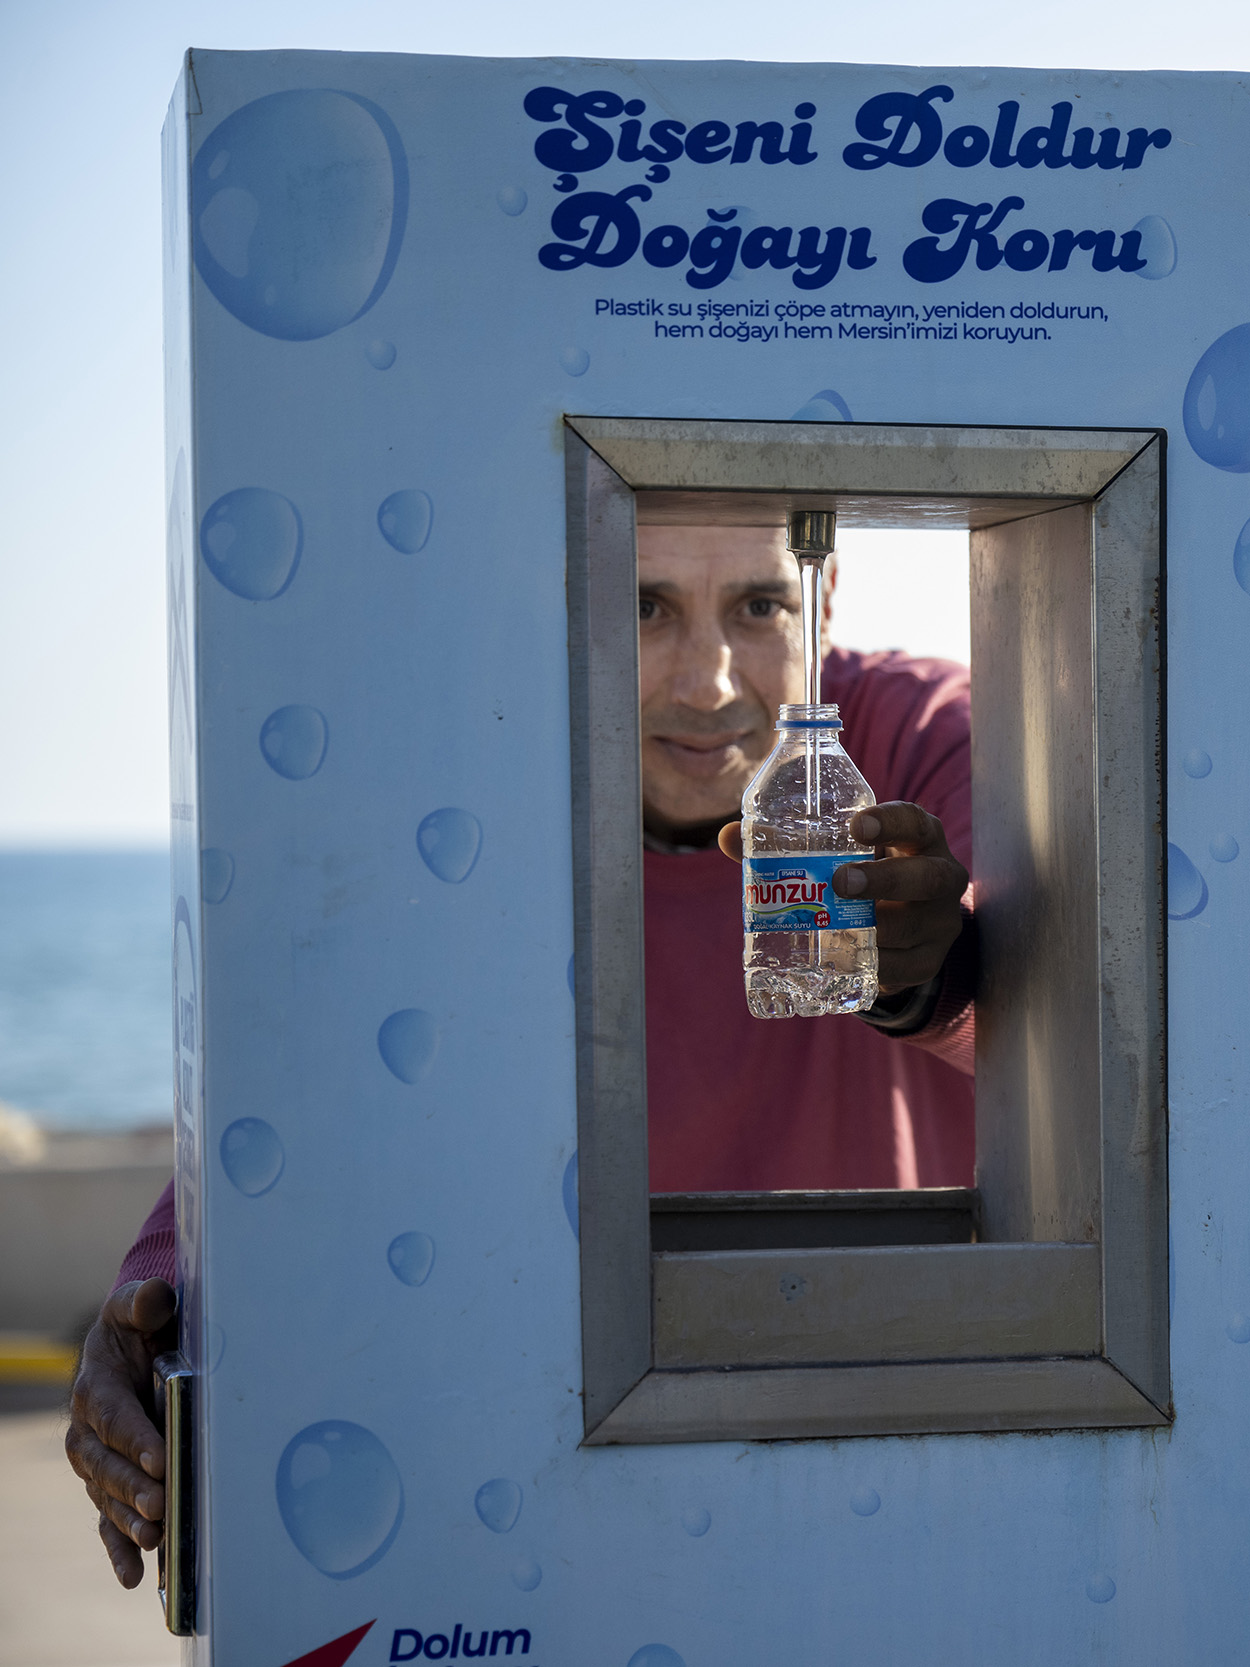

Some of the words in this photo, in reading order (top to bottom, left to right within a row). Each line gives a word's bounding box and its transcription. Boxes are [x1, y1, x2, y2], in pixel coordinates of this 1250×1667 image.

[523, 86, 818, 193] Şişeni
[842, 85, 1172, 171] Doldur
[538, 184, 878, 290] Doğayı
[903, 196, 1147, 284] Koru
[595, 298, 664, 316] Plastik
[668, 303, 692, 316] su
[697, 299, 769, 320] şişenizi
[774, 301, 826, 321] çöpe
[830, 302, 920, 321] atmayın,
[922, 302, 1005, 321] yeniden
[1010, 302, 1109, 322] doldurun,
[655, 320, 703, 338] hem
[708, 321, 778, 342] doğayı
[784, 321, 832, 339] hem
[963, 323, 1052, 344] koruyun.
[745, 883, 828, 904] munzur
[793, 921, 811, 929] SUYU
[817, 912, 828, 920] pH
[389, 1623, 532, 1663] Dolum
